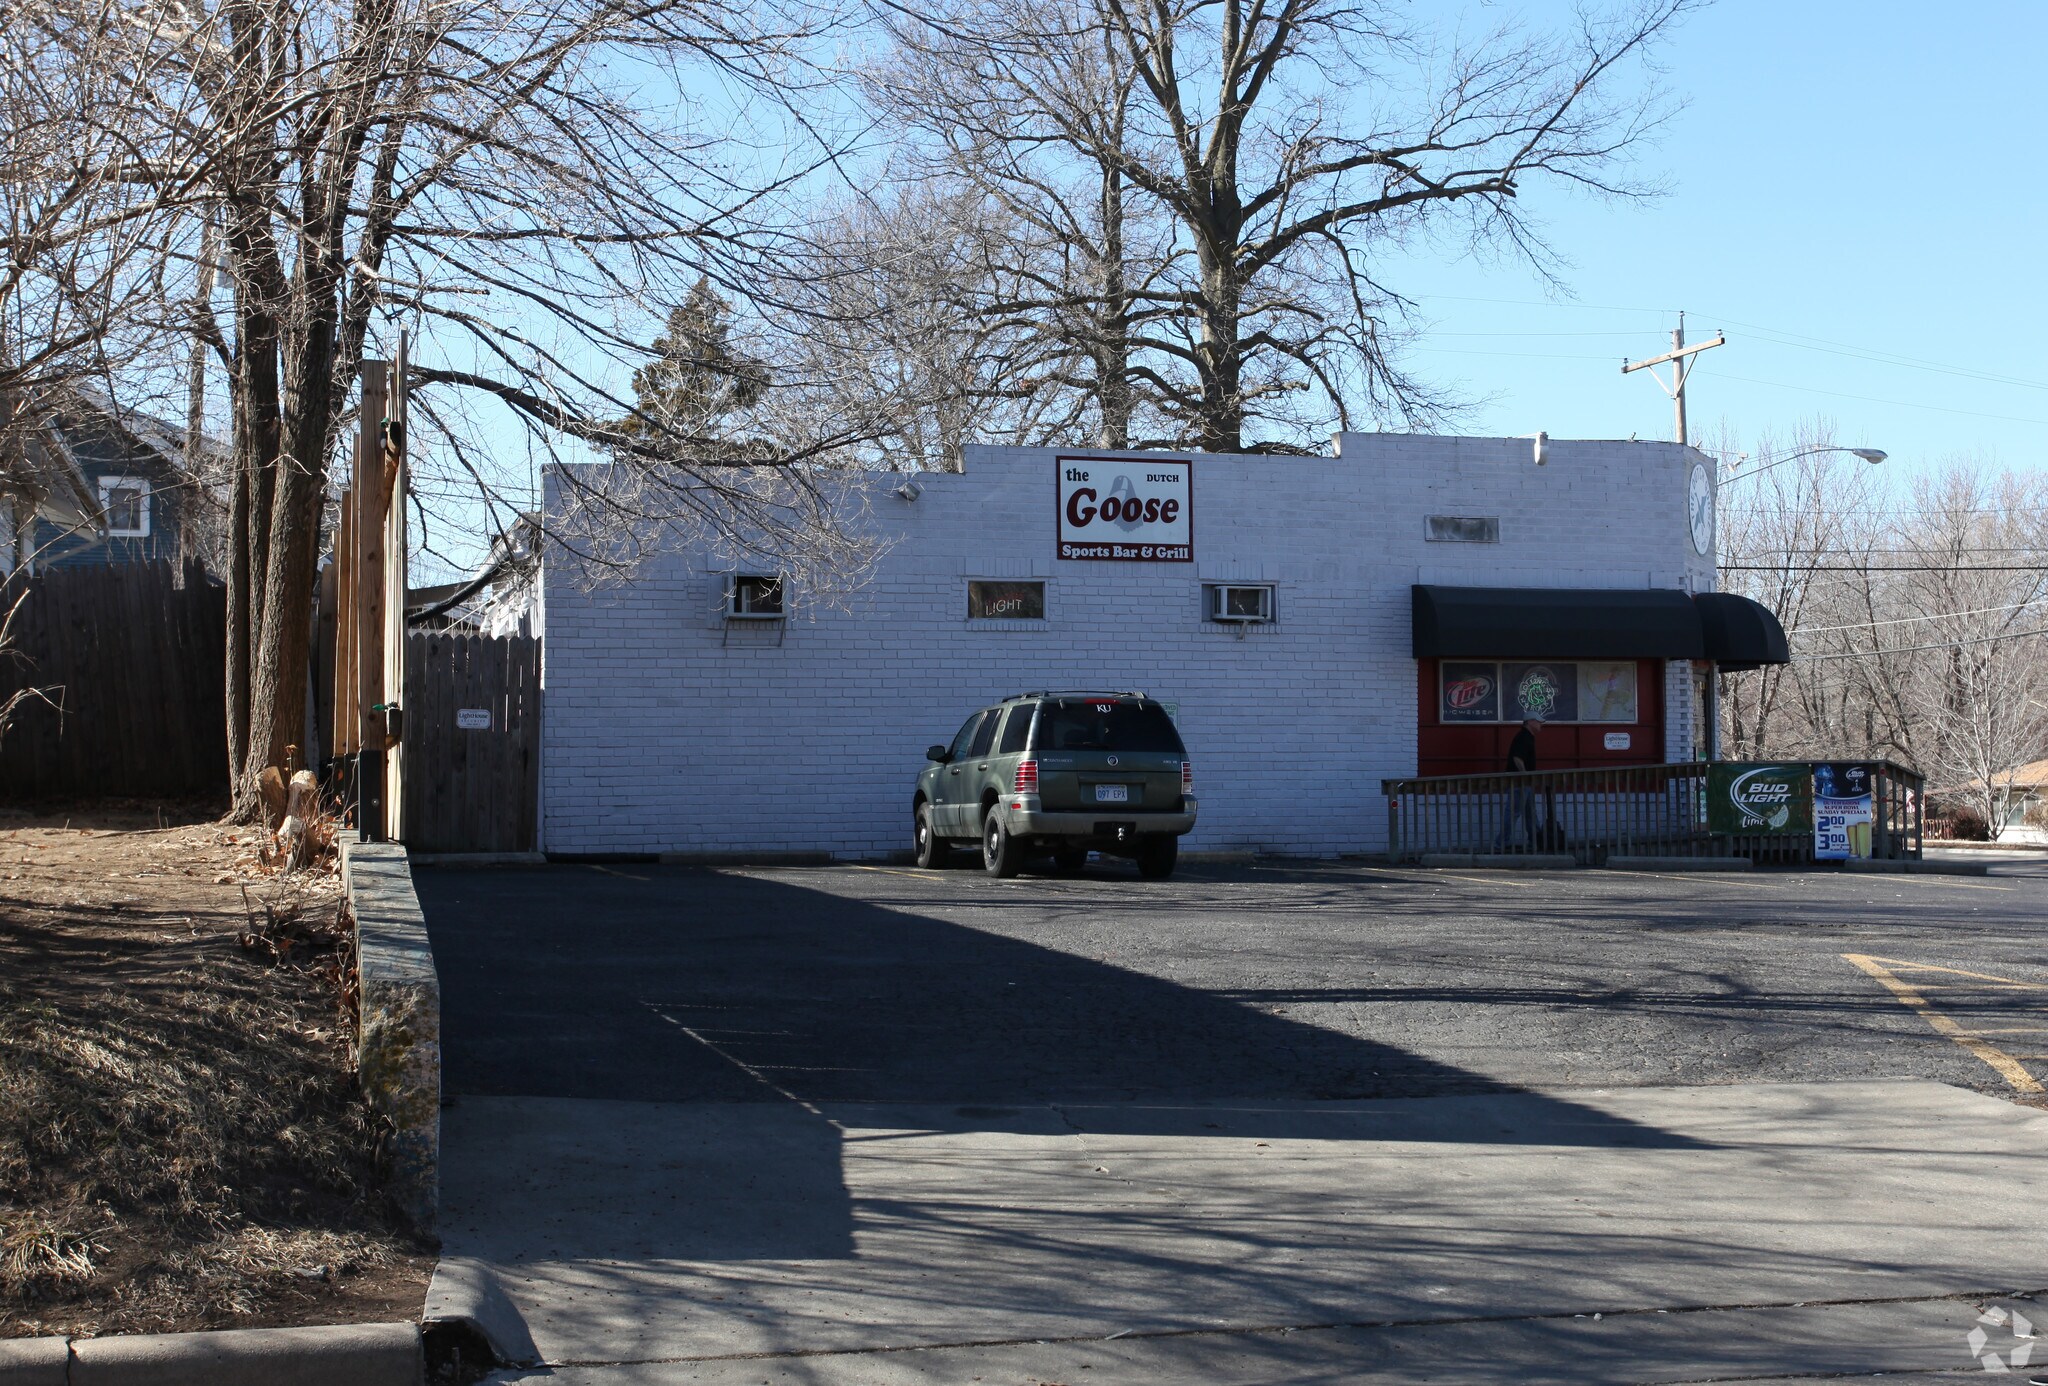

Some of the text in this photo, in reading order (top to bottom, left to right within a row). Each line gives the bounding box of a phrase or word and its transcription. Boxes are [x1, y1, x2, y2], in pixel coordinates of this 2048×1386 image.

[1065, 468, 1090, 482] the
[1146, 474, 1180, 483] DUTCH
[1066, 487, 1180, 528] Goose
[1062, 544, 1189, 560] Sports Bar & Grill
[985, 599, 1023, 616] LIGHT
[1456, 682, 1487, 705] Lite
[1096, 704, 1112, 714] KU
[1748, 783, 1789, 793] BUD
[1098, 789, 1125, 800] 097 EPX
[1739, 793, 1792, 803] LIGHT
[1742, 816, 1765, 828] Lime
